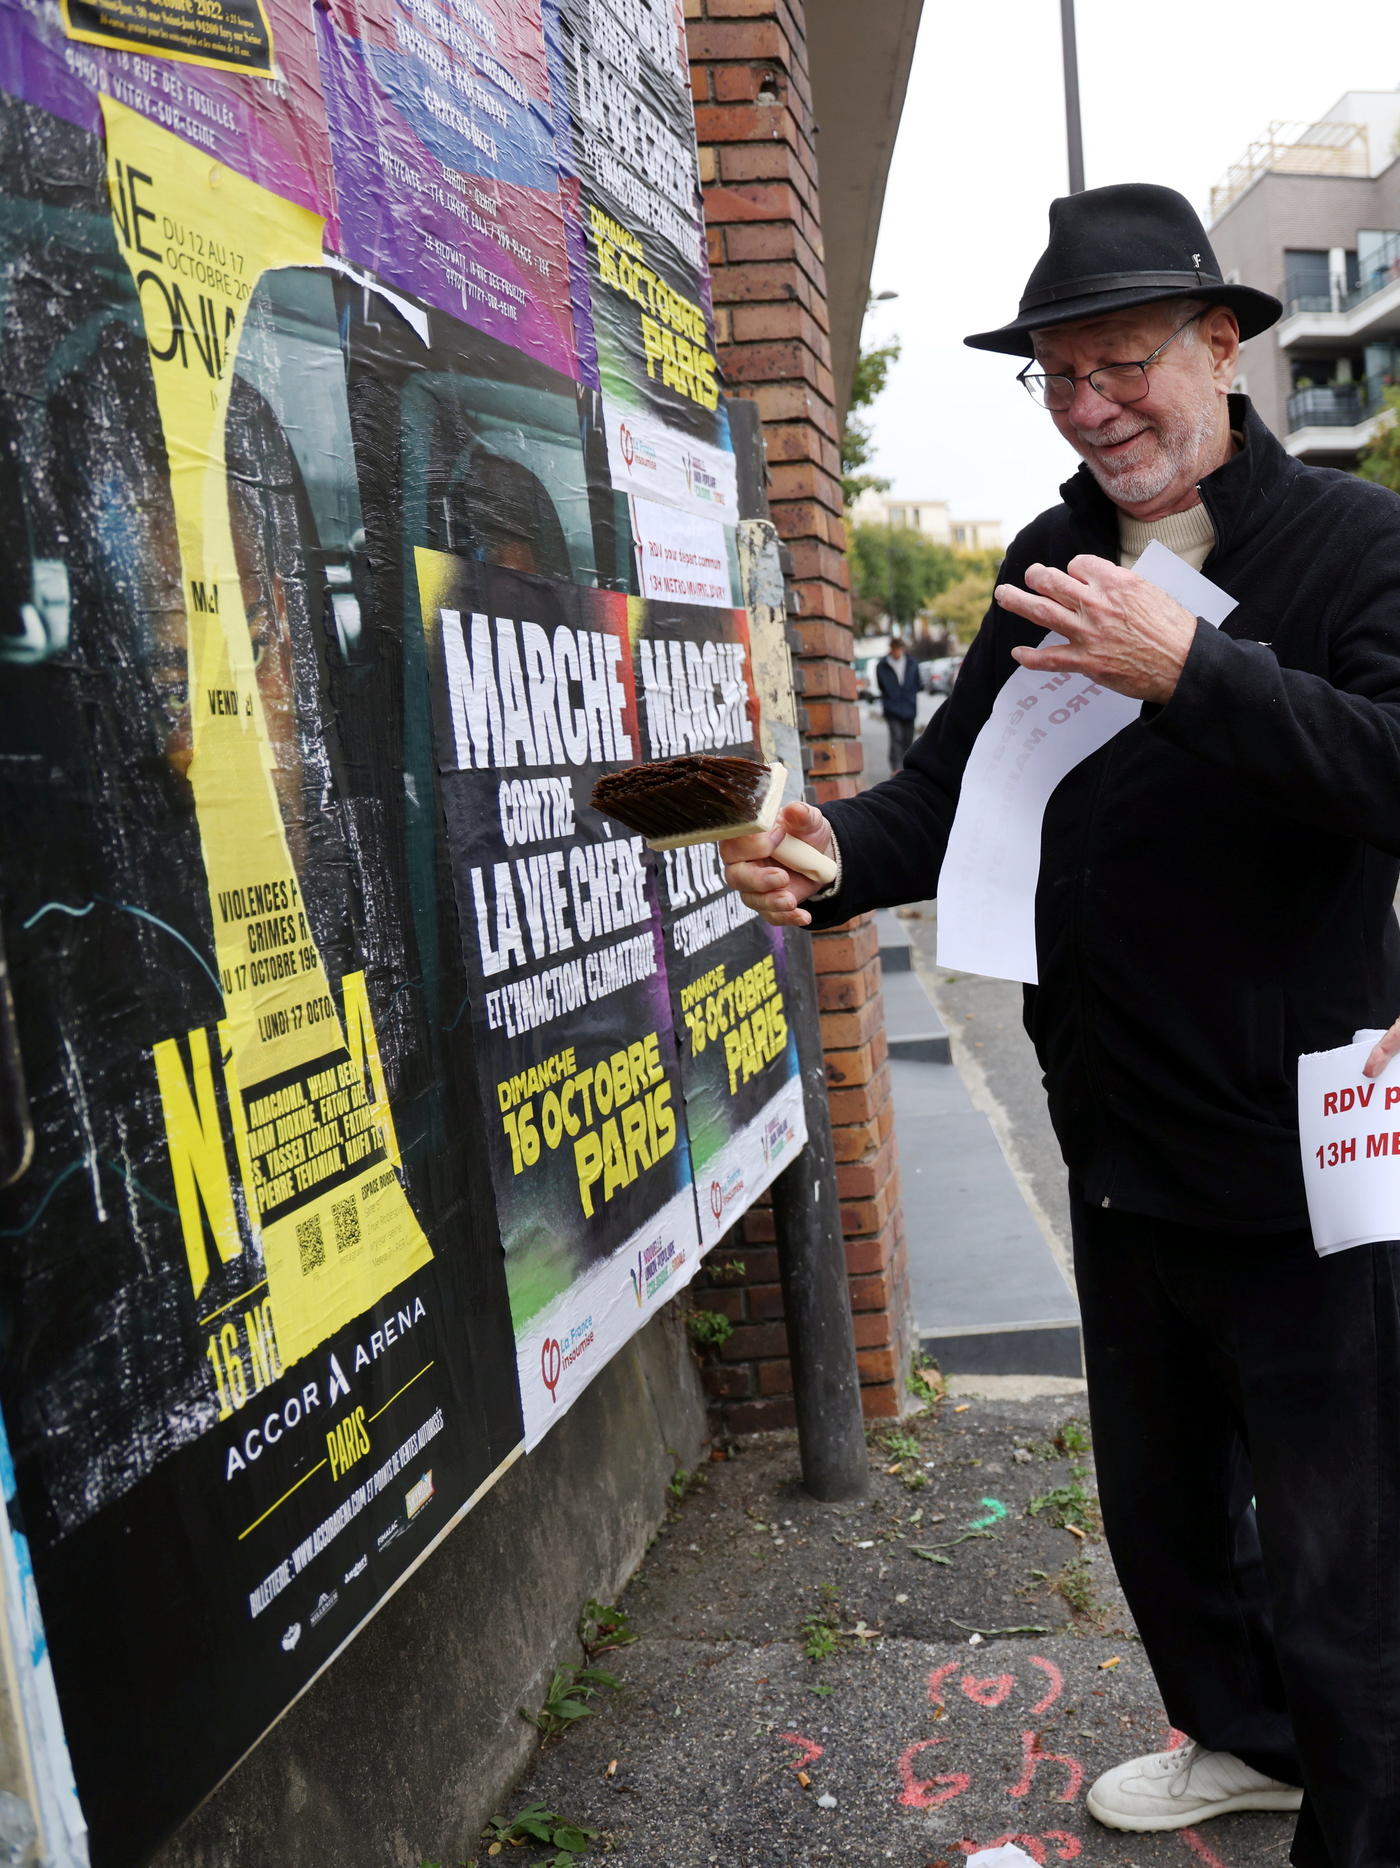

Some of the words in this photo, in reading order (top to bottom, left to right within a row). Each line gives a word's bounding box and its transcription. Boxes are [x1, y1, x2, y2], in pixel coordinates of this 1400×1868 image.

[133, 55, 158, 88] RUE
[162, 71, 184, 101] DES
[112, 76, 217, 150] VITRY-SUR-SEINE
[163, 216, 184, 246] DU
[188, 230, 205, 256] 12
[208, 240, 226, 267] AU
[229, 252, 244, 274] 17
[166, 247, 232, 296] OCTOBRE
[664, 577, 687, 594] METRO
[440, 608, 633, 770] MARCHE
[639, 639, 753, 760] MARCHE
[499, 776, 575, 847] CONTRE
[218, 882, 288, 923] VIOLENCES
[471, 862, 527, 977] LA
[516, 850, 574, 961] VIE
[569, 822, 652, 942] CHÈRE
[663, 847, 697, 911] LA
[688, 842, 724, 899] VIE
[247, 916, 297, 954] CRIMES
[234, 964, 247, 990] 17
[250, 952, 298, 987] OCTOBRE
[486, 990, 502, 1030] ET
[501, 958, 587, 1039] L'INACTION
[585, 931, 658, 1001] CLIMATIQUE
[680, 963, 726, 1012] DIMANCHE
[258, 1005, 290, 1043] LUNDI
[291, 1002, 303, 1027] 17
[684, 1004, 706, 1058] 16
[705, 953, 778, 1041] OCTOBRE
[724, 992, 788, 1096] PARIS
[249, 1082, 309, 1130] ANACAONA,
[497, 1046, 577, 1113] DIMANCHE
[503, 1102, 540, 1176] 16
[541, 1031, 664, 1150] OCTOBRE
[1323, 1083, 1375, 1117] RDV
[266, 1137, 306, 1178] YASSER
[305, 1119, 344, 1159] LOUATI,
[275, 1104, 320, 1146] DIOXINE,
[320, 1088, 351, 1123] FATOU
[256, 1170, 295, 1214] PIERRE
[294, 1146, 346, 1192] TEVANIAN,
[345, 1132, 372, 1165] HAIFA
[574, 1080, 677, 1219] PARIS
[1316, 1138, 1356, 1170] 13H
[361, 1178, 379, 1201] ESPACE
[560, 1338, 570, 1353] La
[570, 1315, 593, 1344] France
[562, 1331, 594, 1371] insoumise
[207, 1323, 247, 1422] 16
[227, 1382, 320, 1480] ACCOR
[355, 1296, 426, 1373] ARENA
[326, 1406, 370, 1481] PARIS
[365, 1478, 374, 1503] ET
[373, 1461, 392, 1496] POINTS
[391, 1453, 400, 1476] DE
[398, 1434, 418, 1468] VENTES
